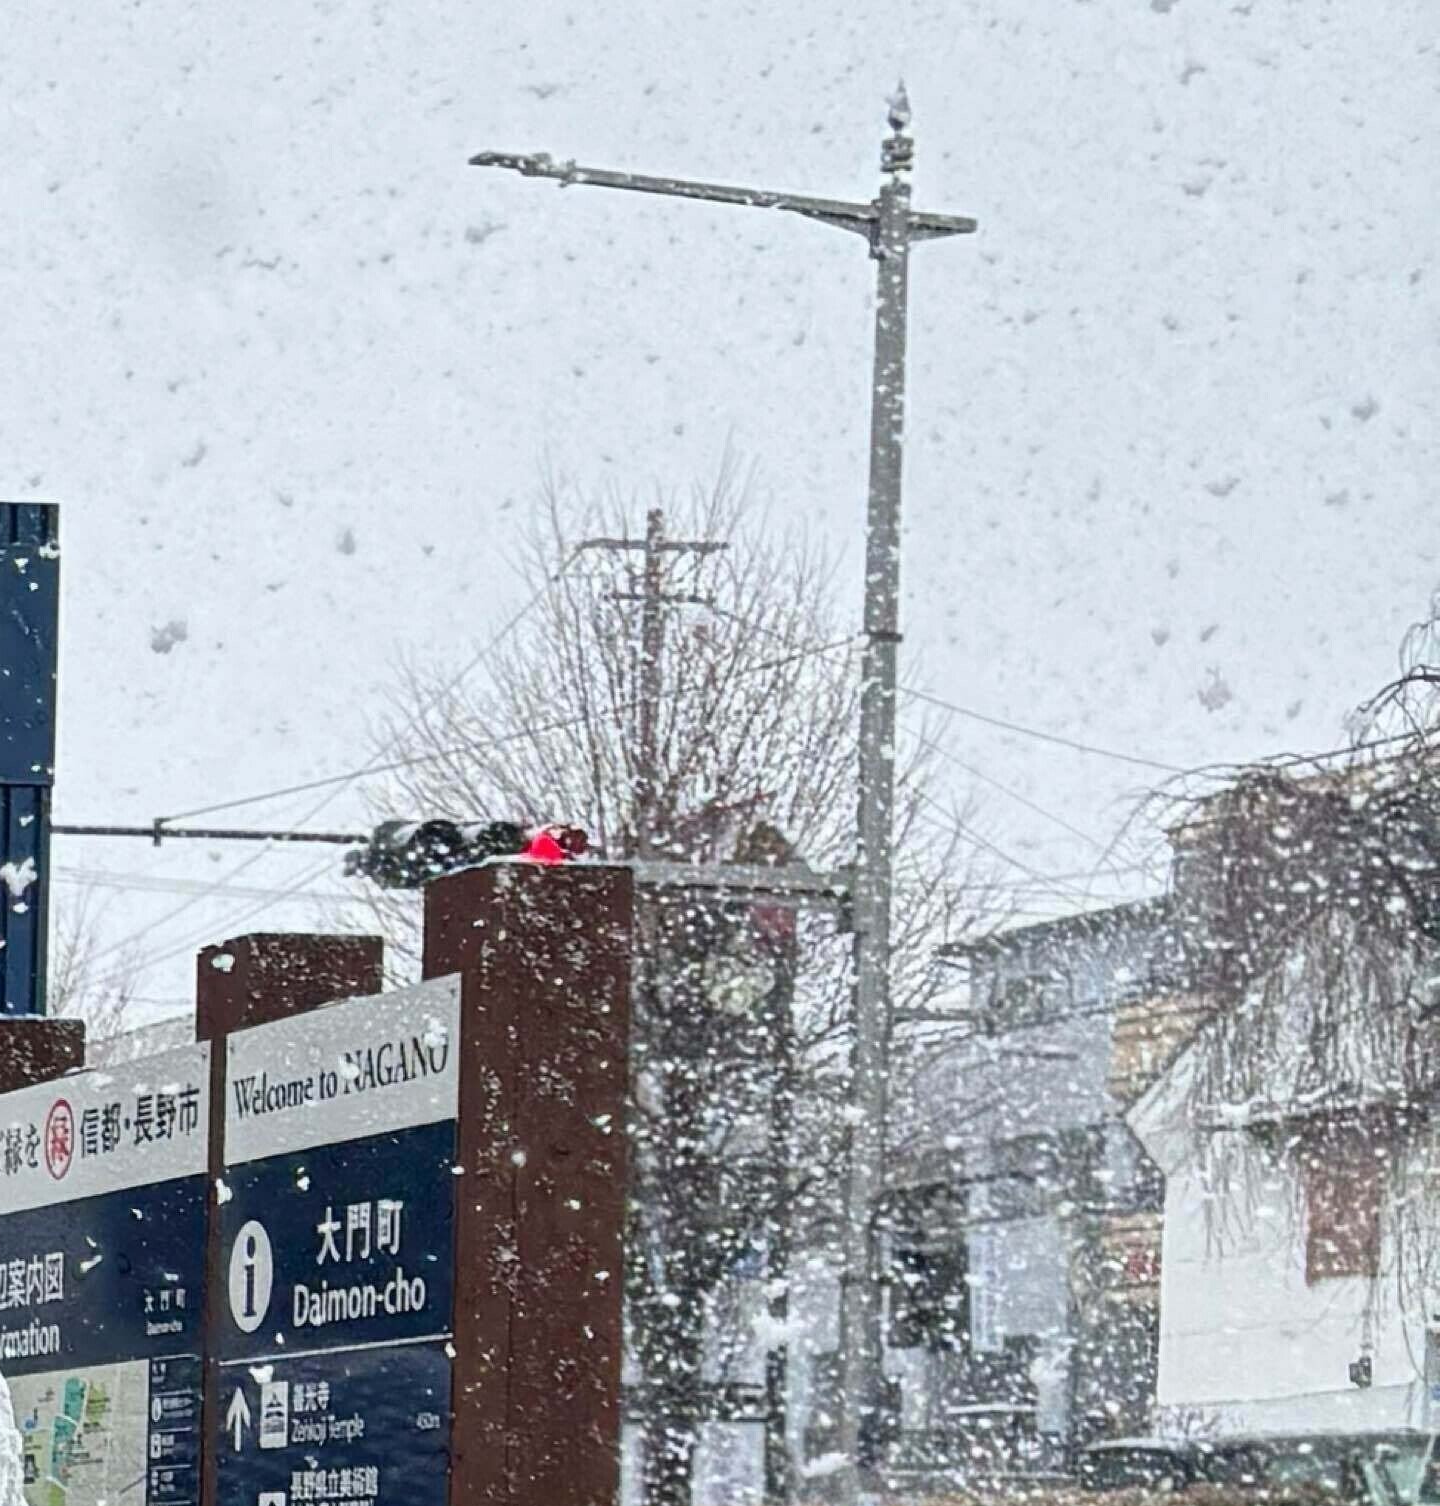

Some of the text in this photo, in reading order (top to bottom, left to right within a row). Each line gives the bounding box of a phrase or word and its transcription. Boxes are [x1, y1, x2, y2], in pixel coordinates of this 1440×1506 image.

[232, 1032, 449, 1120] Welcome to NAGANO
[316, 1198, 403, 1266] 大門町
[293, 1266, 426, 1328] Daimon-cho
